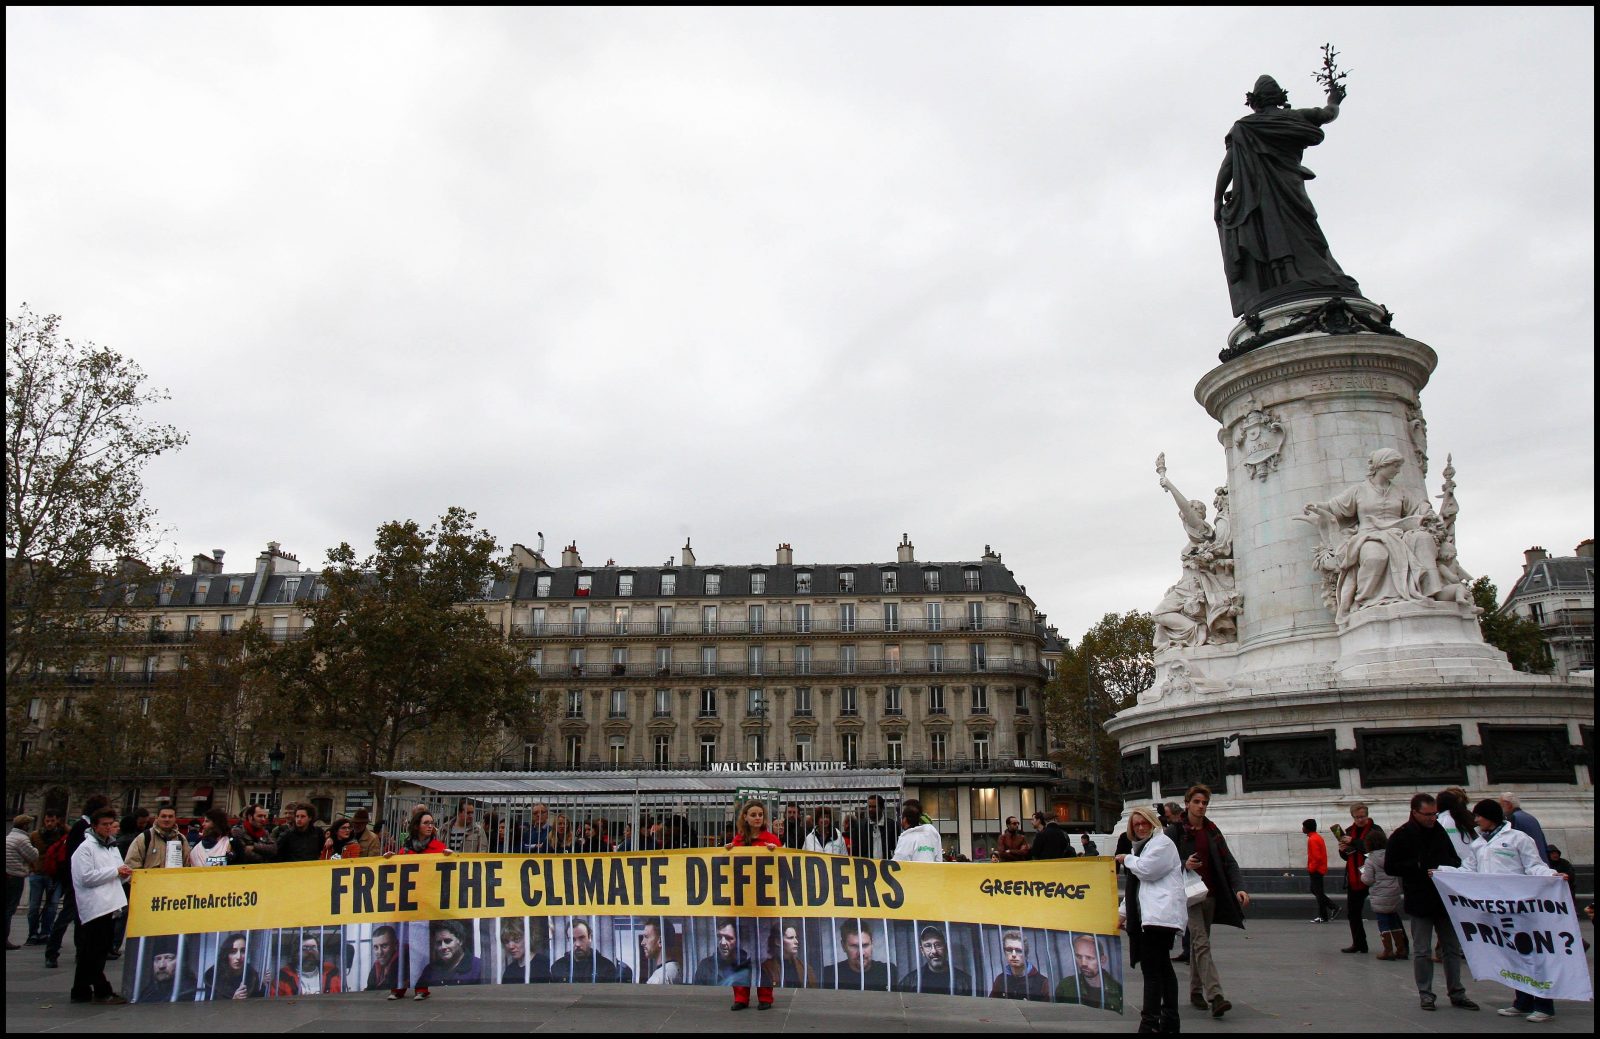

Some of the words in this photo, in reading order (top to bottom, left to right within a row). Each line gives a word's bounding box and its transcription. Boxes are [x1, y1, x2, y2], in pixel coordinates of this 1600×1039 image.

[711, 762, 742, 773] WALL
[746, 762, 787, 772] STREET
[790, 761, 847, 771] INSTITUTE
[1013, 759, 1030, 768] WALL
[1030, 760, 1051, 769] STREET
[738, 789, 779, 801] FREE
[331, 863, 419, 915] FREE
[435, 860, 505, 909] THE
[520, 857, 670, 907] CLIMATE
[686, 856, 905, 910] DEFENDERS
[980, 878, 1091, 900] GREENPEACE
[151, 891, 258, 912] #FreeTheArctic30
[1448, 894, 1569, 915] PROTESTATION
[1500, 968, 1554, 989] GREENPEACE
